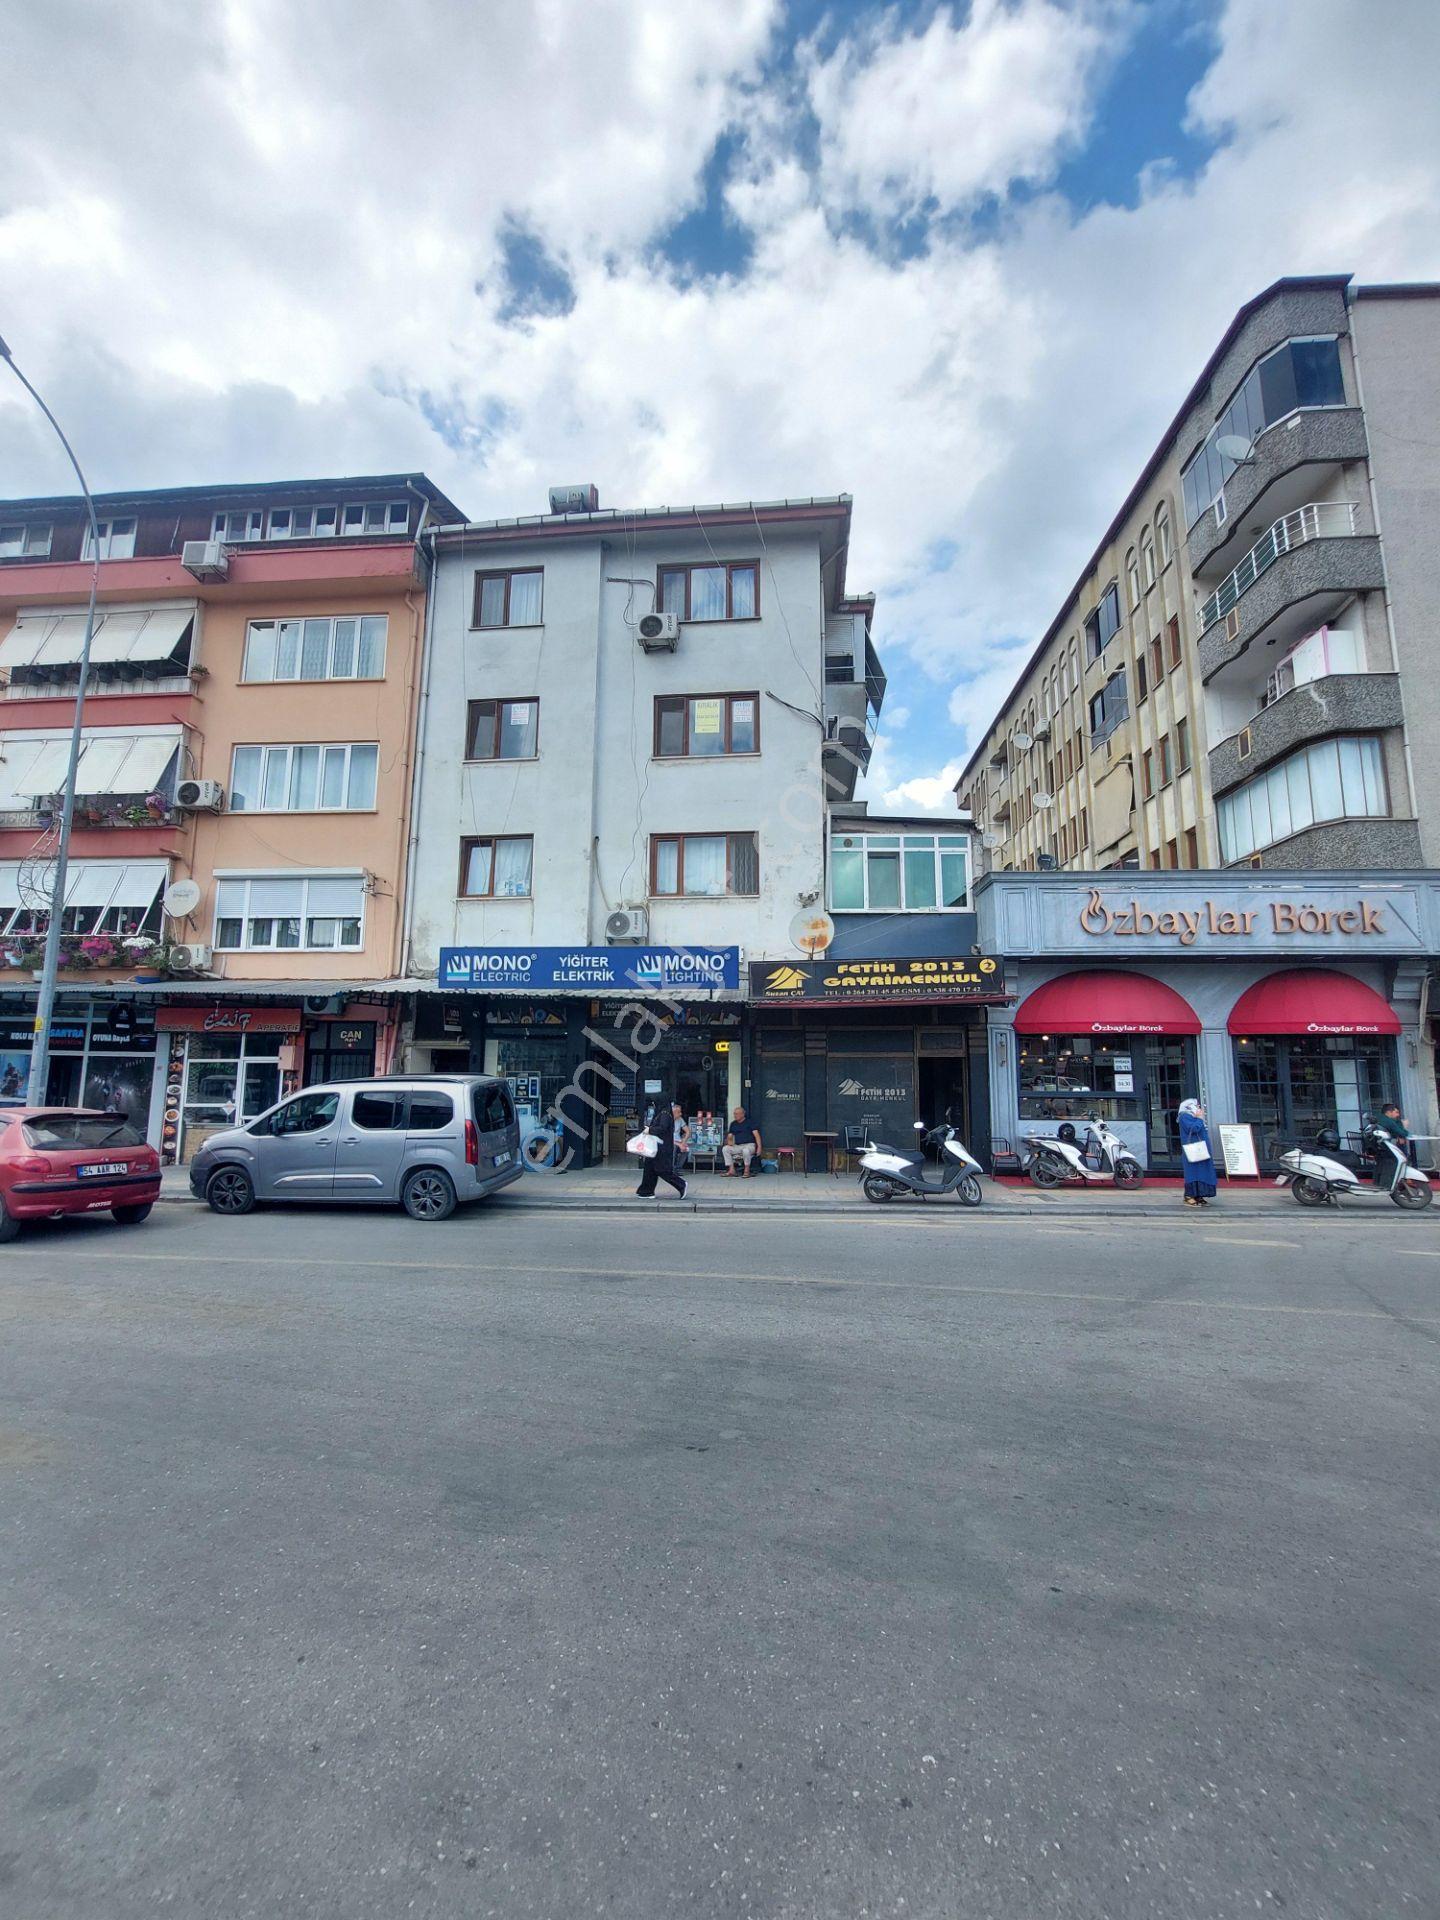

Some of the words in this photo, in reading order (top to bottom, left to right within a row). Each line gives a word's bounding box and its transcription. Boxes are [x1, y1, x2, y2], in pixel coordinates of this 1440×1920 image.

[1080, 889, 1259, 946] Özbaylar
[1270, 900, 1387, 935] Börek
[559, 954, 609, 968] YİĞİTER
[837, 961, 896, 974] FETİH
[909, 961, 966, 972] 2013
[473, 972, 531, 982] ELECTRIC
[553, 968, 615, 981] ELEKTRİK
[822, 973, 982, 989] GAYRİMENKUL
[1091, 1022, 1137, 1032] Özbaylar
[1138, 1024, 1164, 1032] Börek
[1307, 1022, 1354, 1033] Özbaylar
[1356, 1024, 1379, 1032] Börek
[340, 1030, 362, 1039] CAN
[84, 1166, 93, 1175] 54
[113, 1163, 126, 1172] 124
